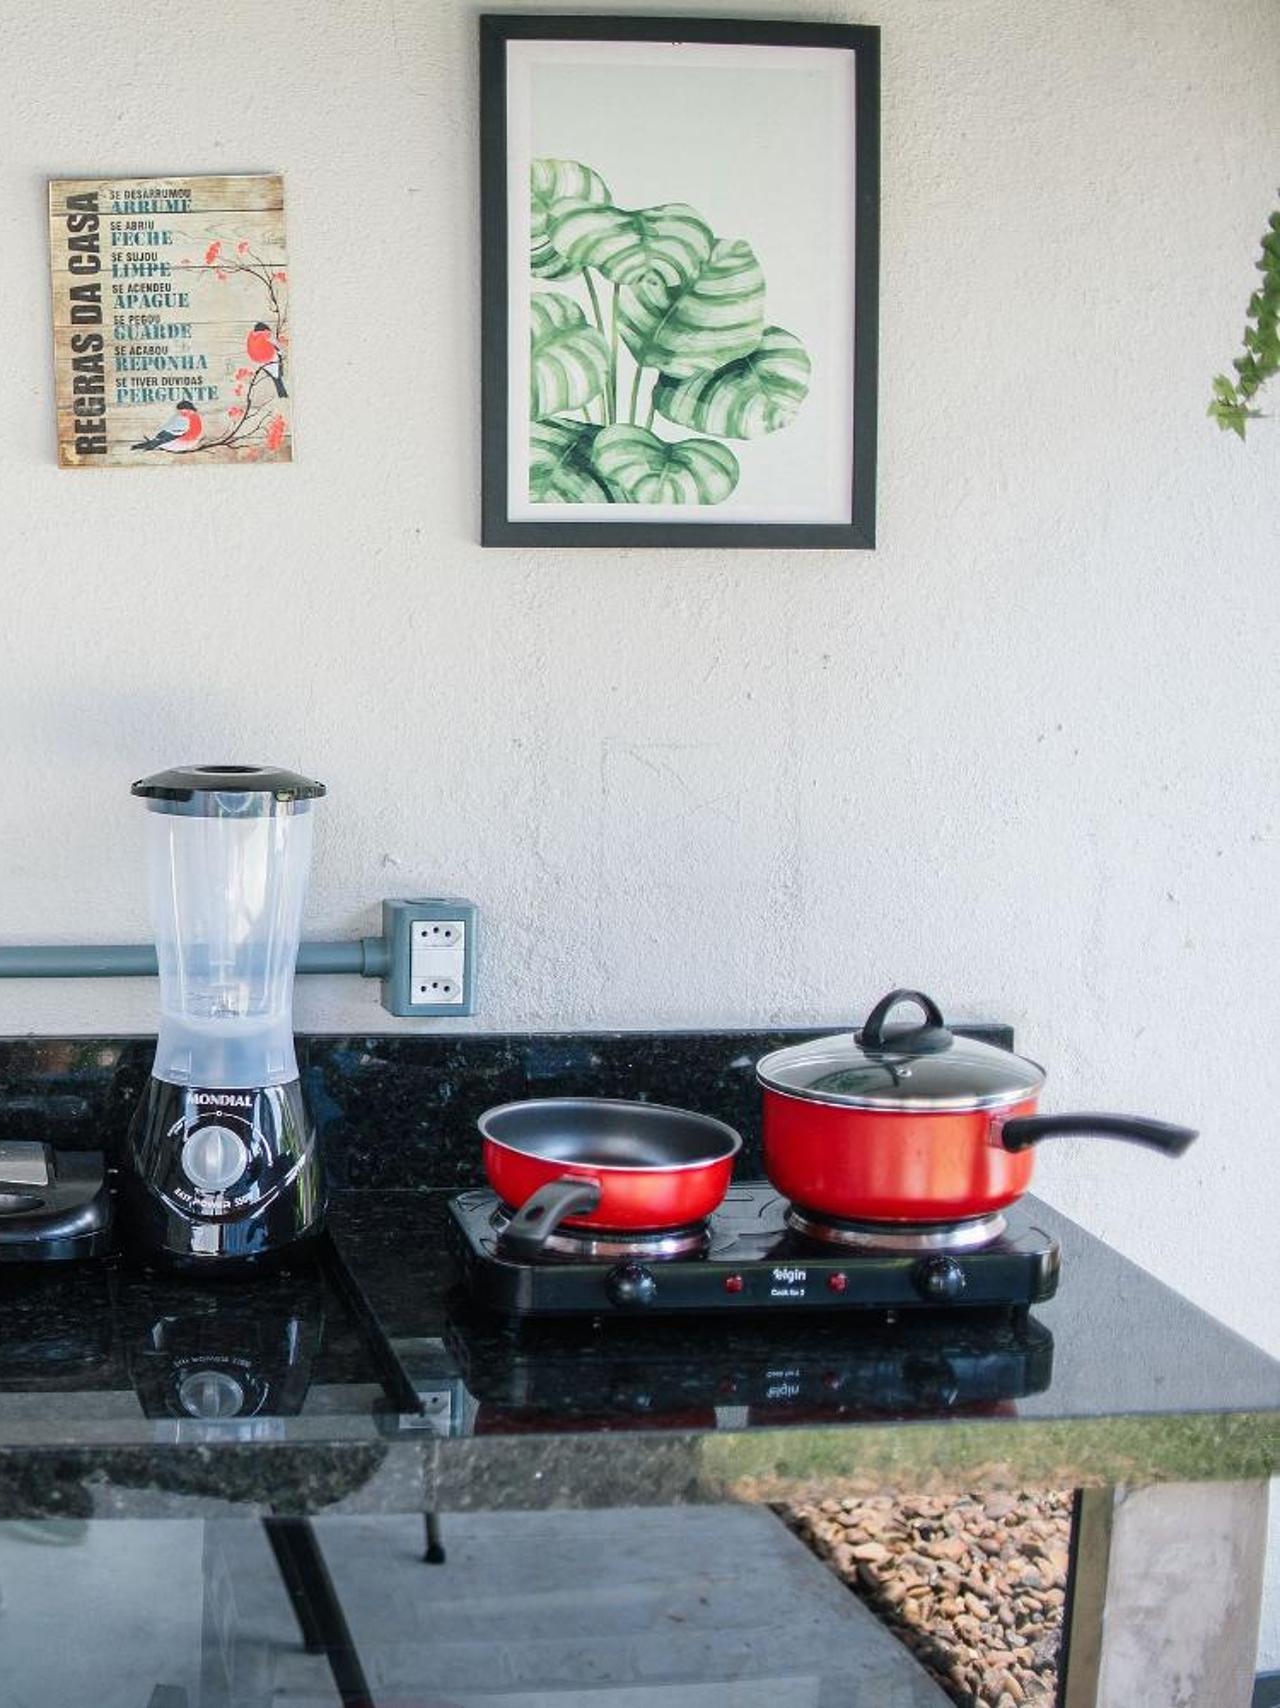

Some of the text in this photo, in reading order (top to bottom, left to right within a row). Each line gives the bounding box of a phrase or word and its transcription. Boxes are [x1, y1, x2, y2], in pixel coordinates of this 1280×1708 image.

[110, 188, 192, 199] SE DESARRUMOU
[112, 199, 192, 213] ARRUME
[110, 220, 154, 231] SE ABRIU
[112, 231, 173, 246] FECHE
[111, 252, 158, 262] SE SUJOU
[112, 262, 171, 278] LIMPE
[112, 283, 171, 294] SE ACENDEU
[113, 293, 190, 309] APAGUE
[66, 191, 107, 455] REGRAS DA CASA
[114, 315, 160, 325] SE PEGOU
[114, 323, 192, 340] GUARDE
[114, 346, 168, 356] SE ACABOU
[115, 355, 208, 372] REPONHA
[115, 378, 127, 388] SE
[131, 377, 158, 387] TIVER
[116, 385, 219, 403] PERGUNTE
[188, 1093, 253, 1107] MONDIAL
